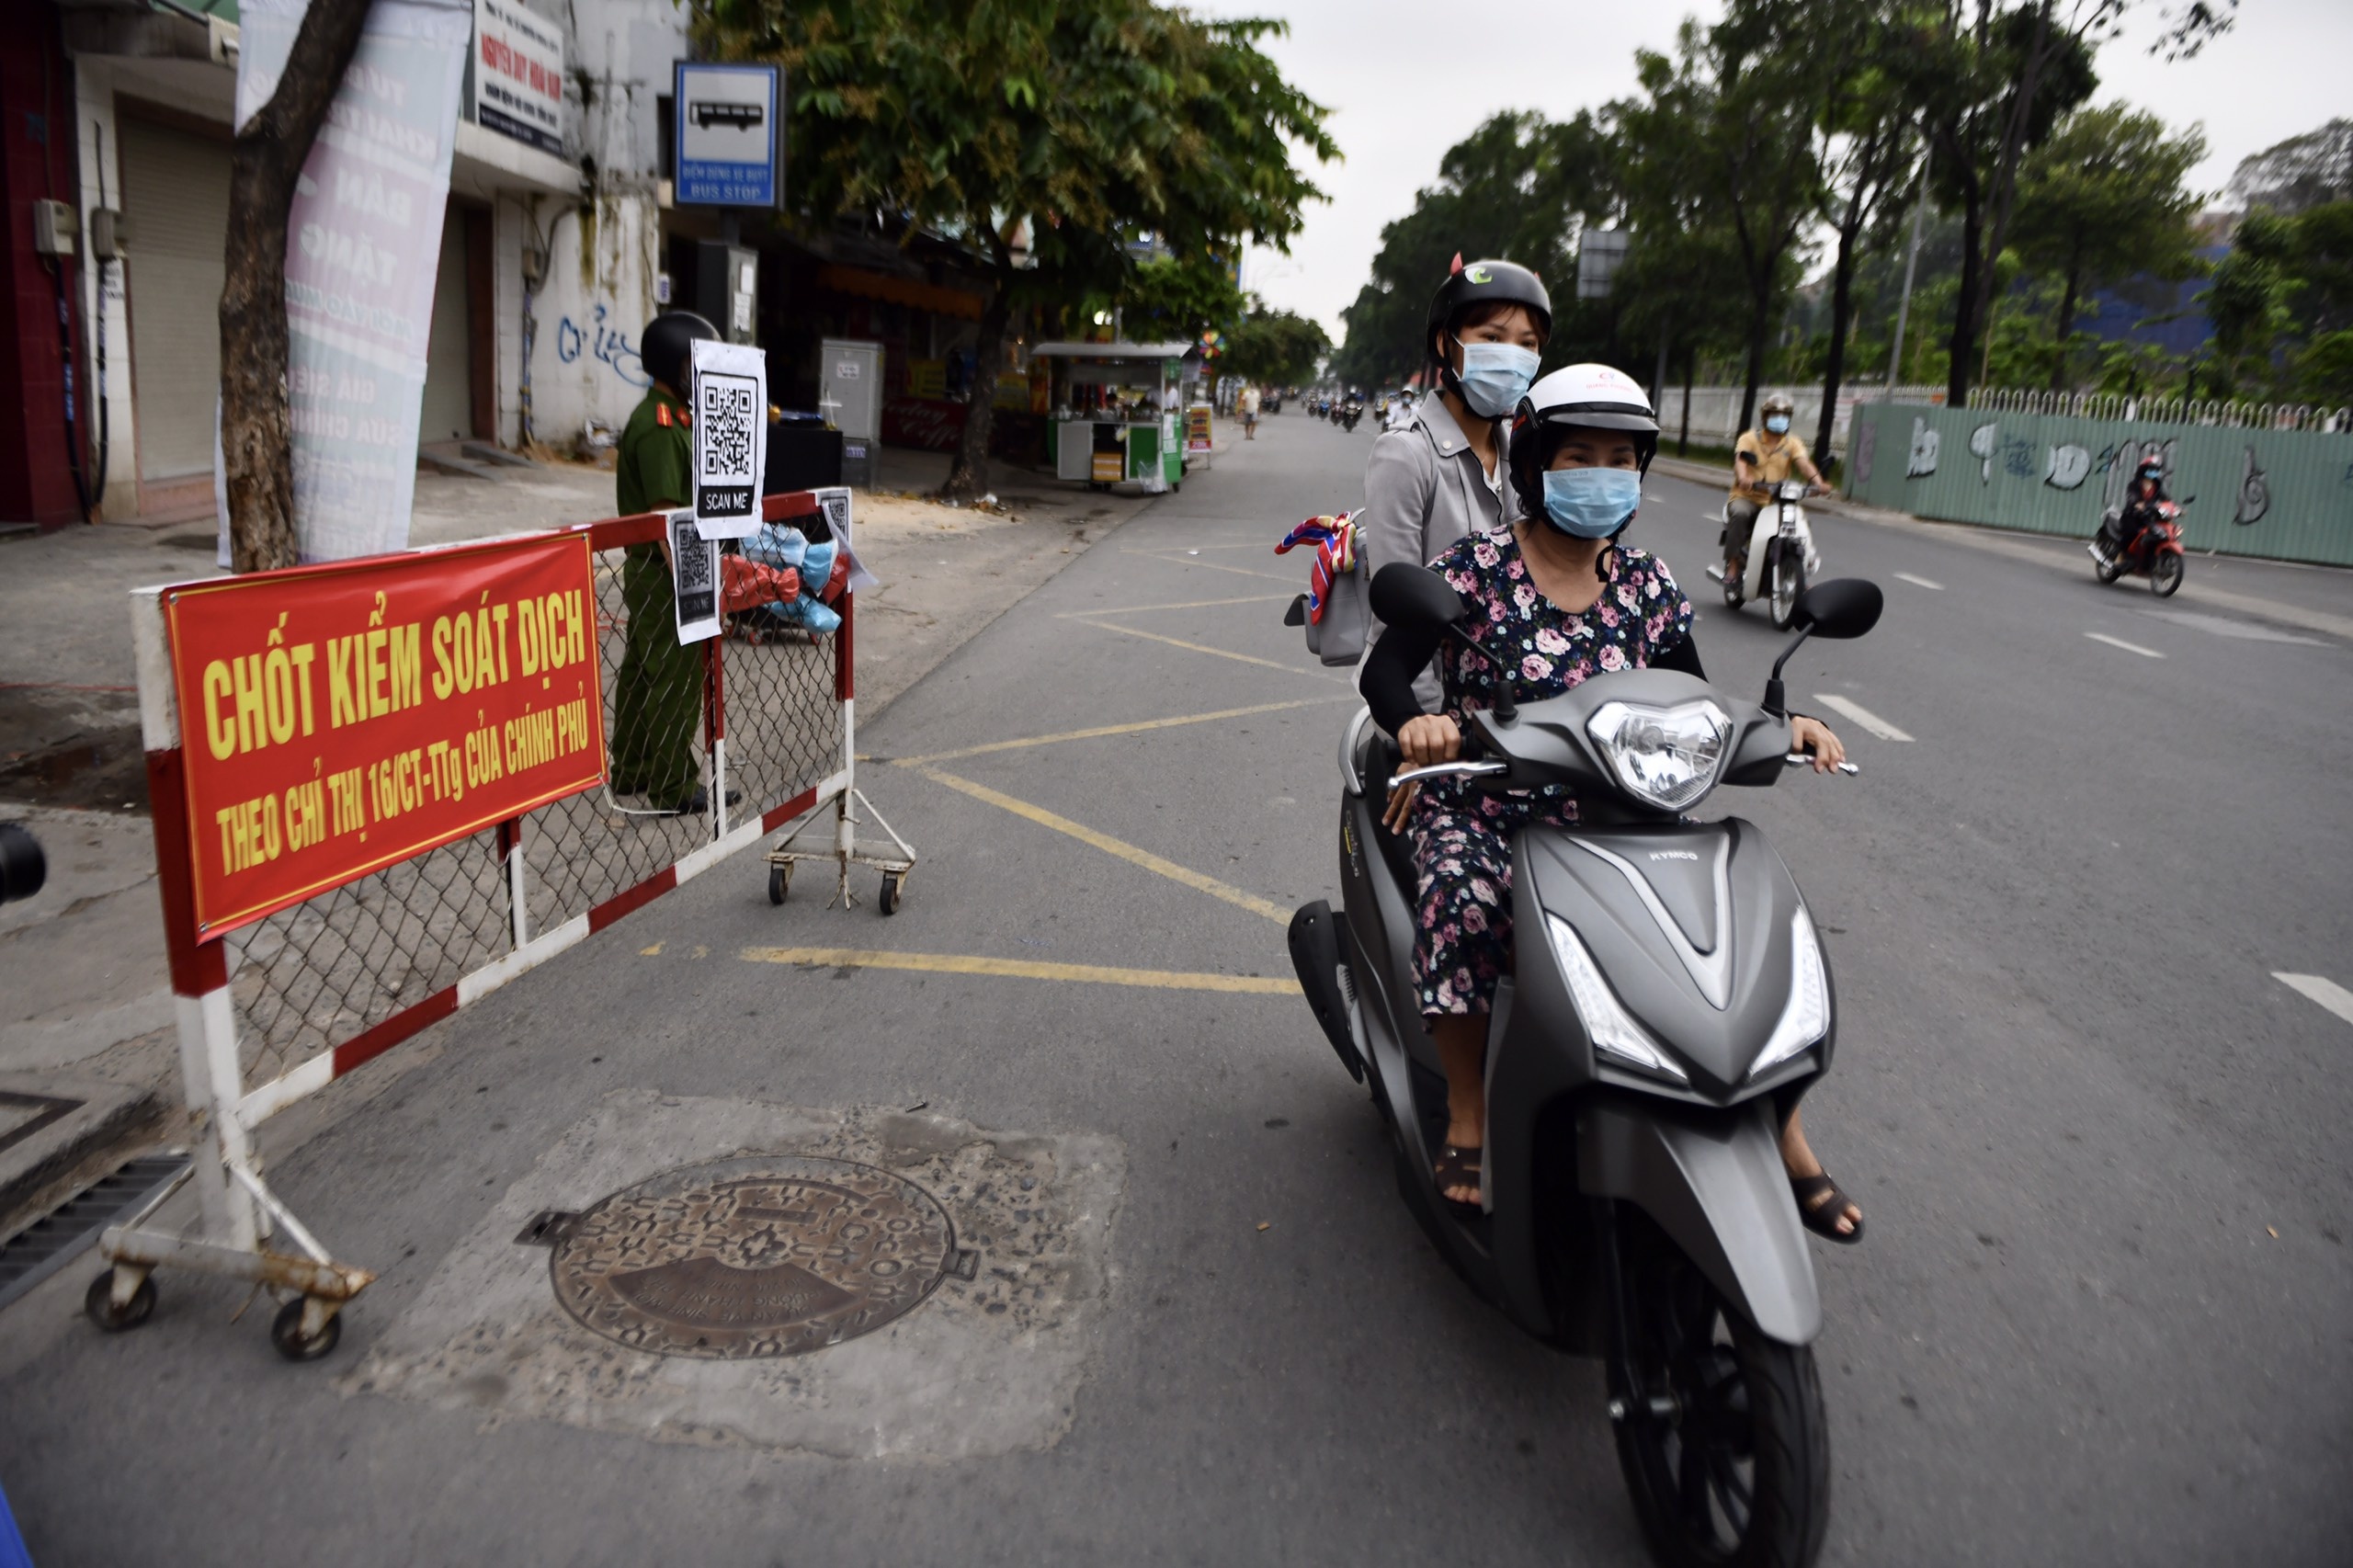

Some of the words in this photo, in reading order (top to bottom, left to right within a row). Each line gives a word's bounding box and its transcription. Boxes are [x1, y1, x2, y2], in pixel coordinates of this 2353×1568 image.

[691, 185, 720, 199] BUS
[724, 186, 761, 200] STOP
[706, 494, 730, 510] SCAN
[733, 492, 748, 509] ME
[203, 611, 315, 761] CHỐT
[327, 590, 422, 729] KIỂM
[432, 590, 509, 700] SOÁT
[517, 589, 585, 690] DỊCH
[216, 793, 281, 876] THEO
[285, 756, 325, 853] CHỈ
[327, 767, 367, 843] THỊ
[369, 739, 463, 823] 16/CT-TTg
[465, 710, 504, 789] CỦA
[505, 702, 556, 775] CHÍNH
[557, 680, 588, 756] PHỦ
[1648, 851, 1699, 861] KYMCO
